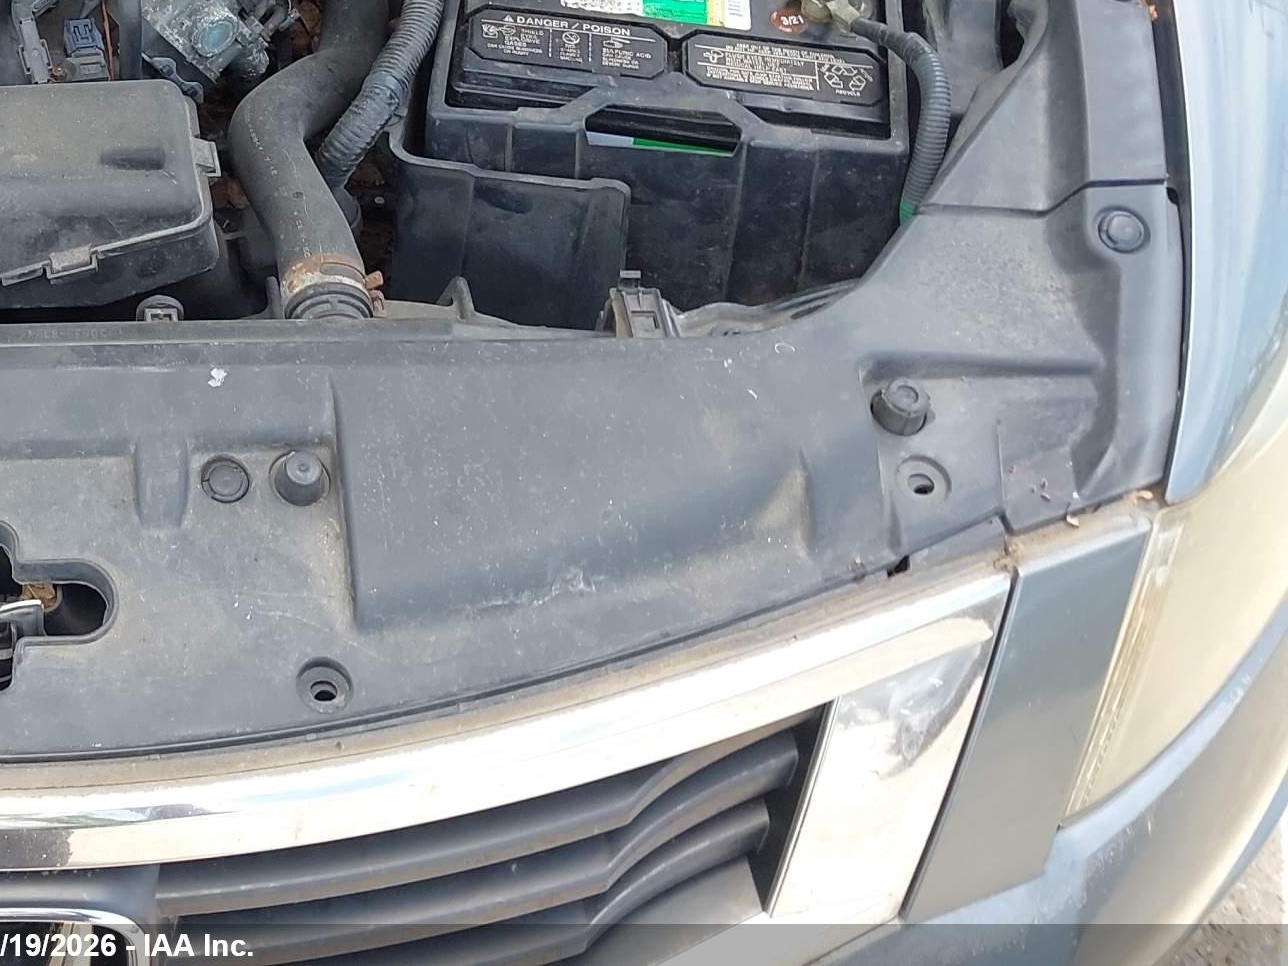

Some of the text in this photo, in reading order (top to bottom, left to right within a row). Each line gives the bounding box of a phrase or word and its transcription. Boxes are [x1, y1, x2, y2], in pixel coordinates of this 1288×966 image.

[516, 16, 569, 29] DANGER
[583, 23, 631, 36] POISON
[780, 14, 805, 26] 3/21
